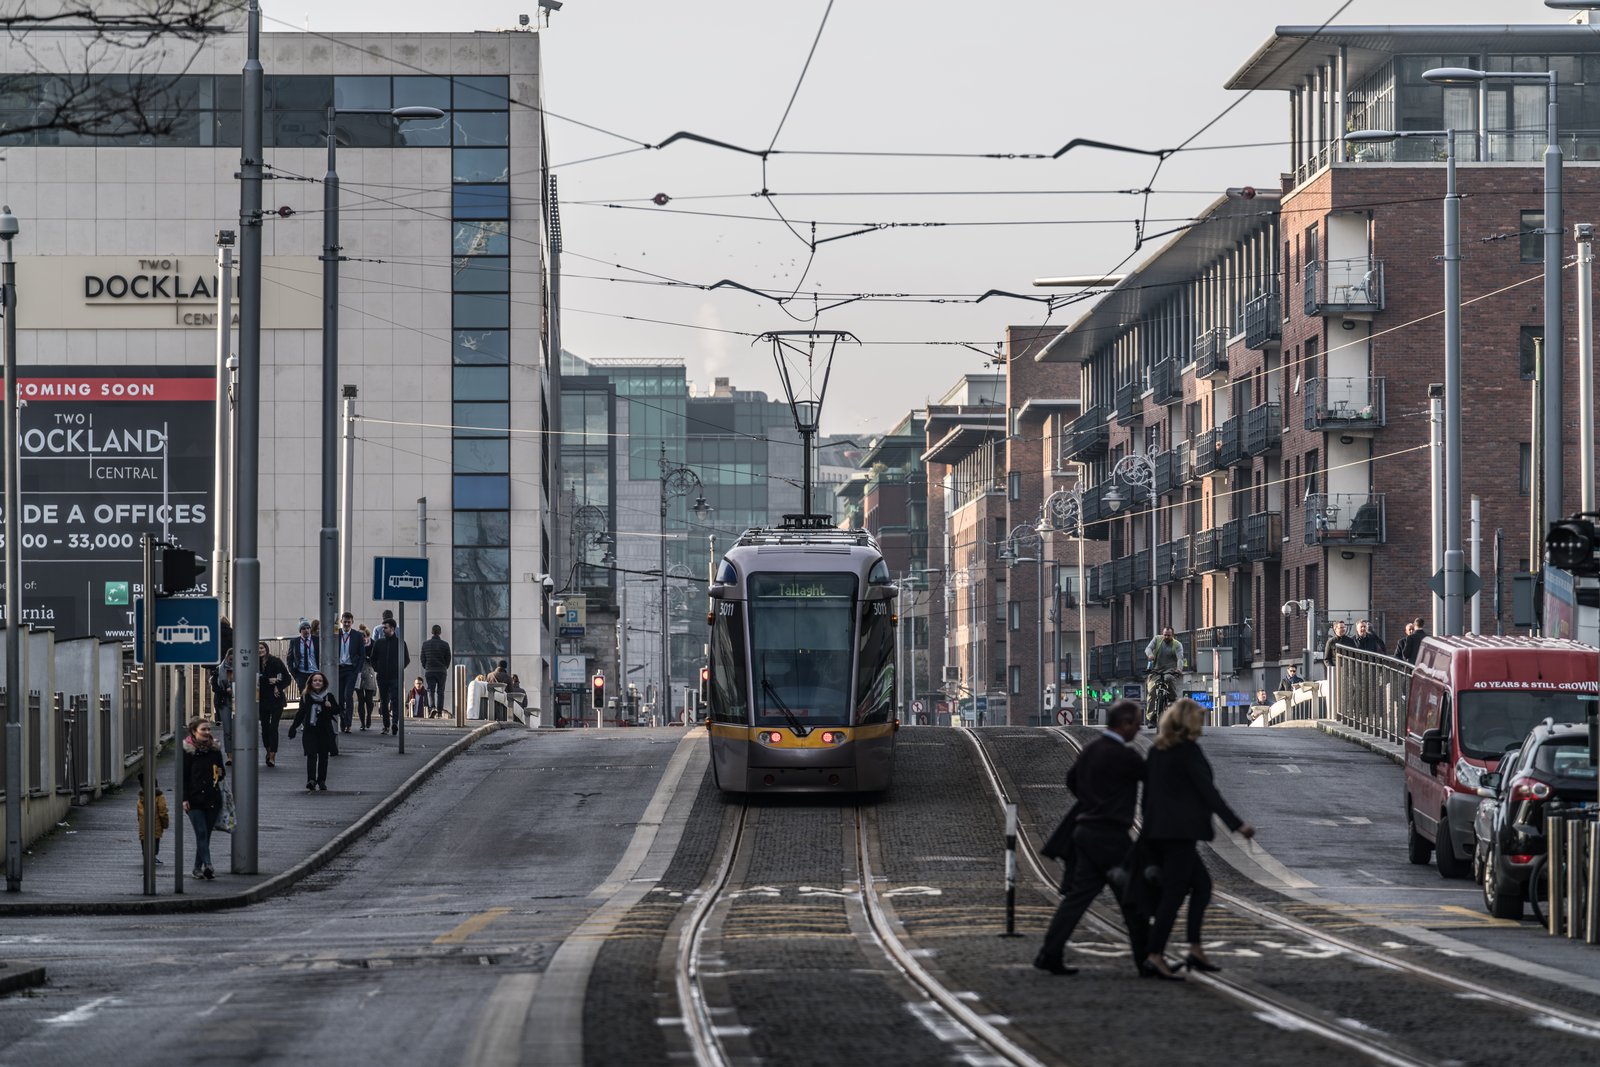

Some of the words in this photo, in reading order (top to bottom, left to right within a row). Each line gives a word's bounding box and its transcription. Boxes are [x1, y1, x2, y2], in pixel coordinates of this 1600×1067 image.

[138, 259, 172, 271] TWO
[85, 274, 240, 299] DOCKLA
[101, 383, 155, 396] SOON
[54, 413, 85, 425] TWO
[20, 428, 165, 453] OCKLAND
[96, 466, 158, 480] CENTRAL
[66, 504, 86, 524] A
[94, 504, 206, 524] OFFICES
[68, 533, 134, 551] 33,000
[24, 580, 37, 590] of:
[779, 584, 826, 597] Tallaght
[719, 602, 735, 616] 3011
[872, 602, 888, 616] 3011
[568, 611, 576, 622] P
[1474, 681, 1487, 689] 40
[1488, 681, 1520, 689] YEARS
[1531, 681, 1557, 689] STILL
